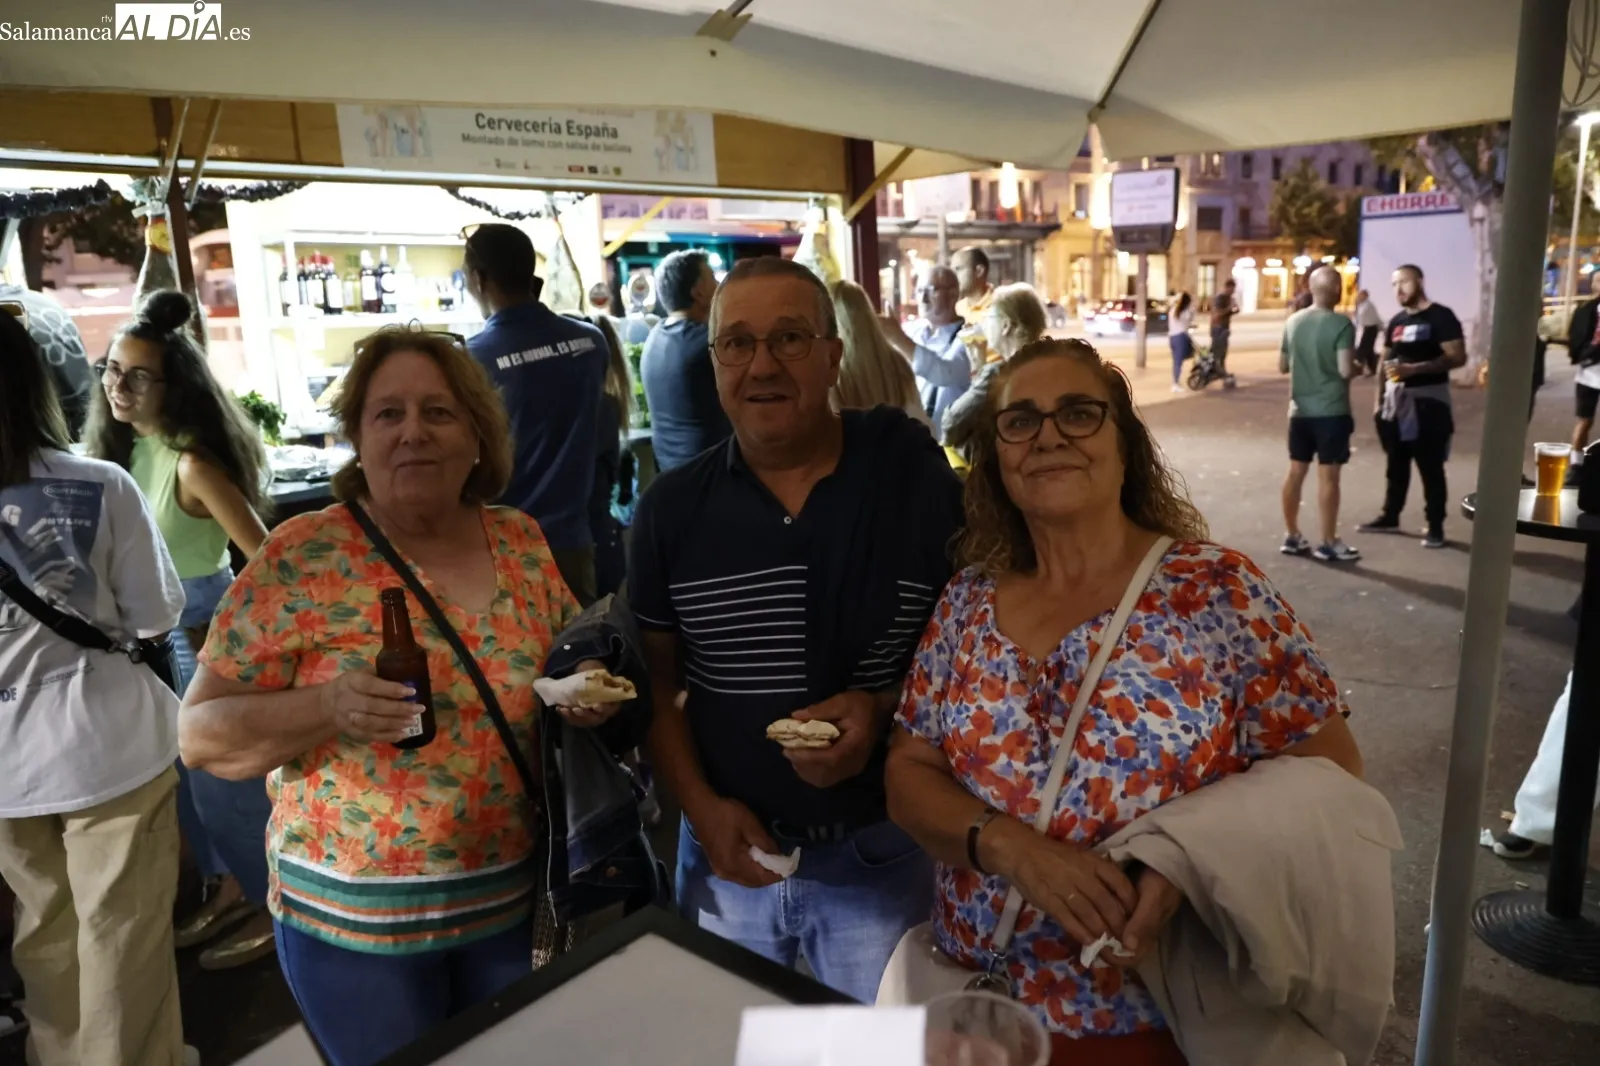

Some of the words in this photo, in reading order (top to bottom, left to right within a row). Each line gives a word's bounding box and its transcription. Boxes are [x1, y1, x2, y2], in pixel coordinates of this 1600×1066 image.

[475, 112, 562, 135] Cervecería
[566, 119, 618, 140] España
[461, 132, 505, 146] Montado
[507, 136, 519, 147] de
